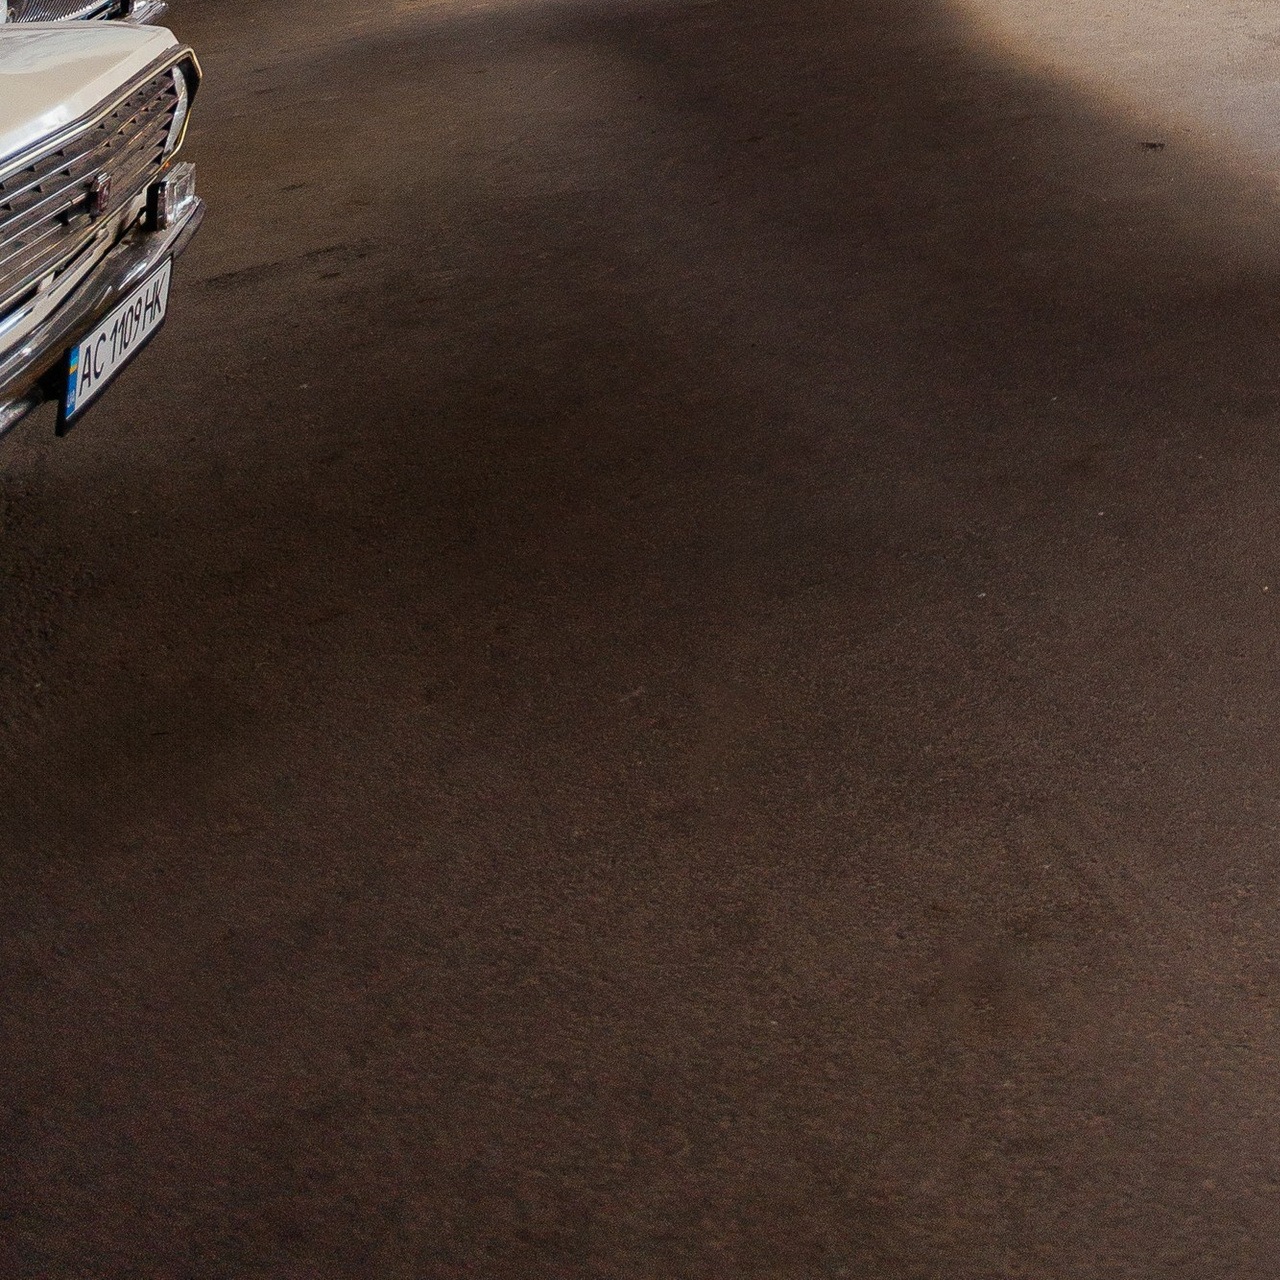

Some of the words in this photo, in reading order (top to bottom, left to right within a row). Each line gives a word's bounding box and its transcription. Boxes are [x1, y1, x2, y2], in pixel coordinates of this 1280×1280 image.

[78, 332, 107, 398] AC
[110, 295, 143, 364] 1109
[142, 271, 167, 332] HK
